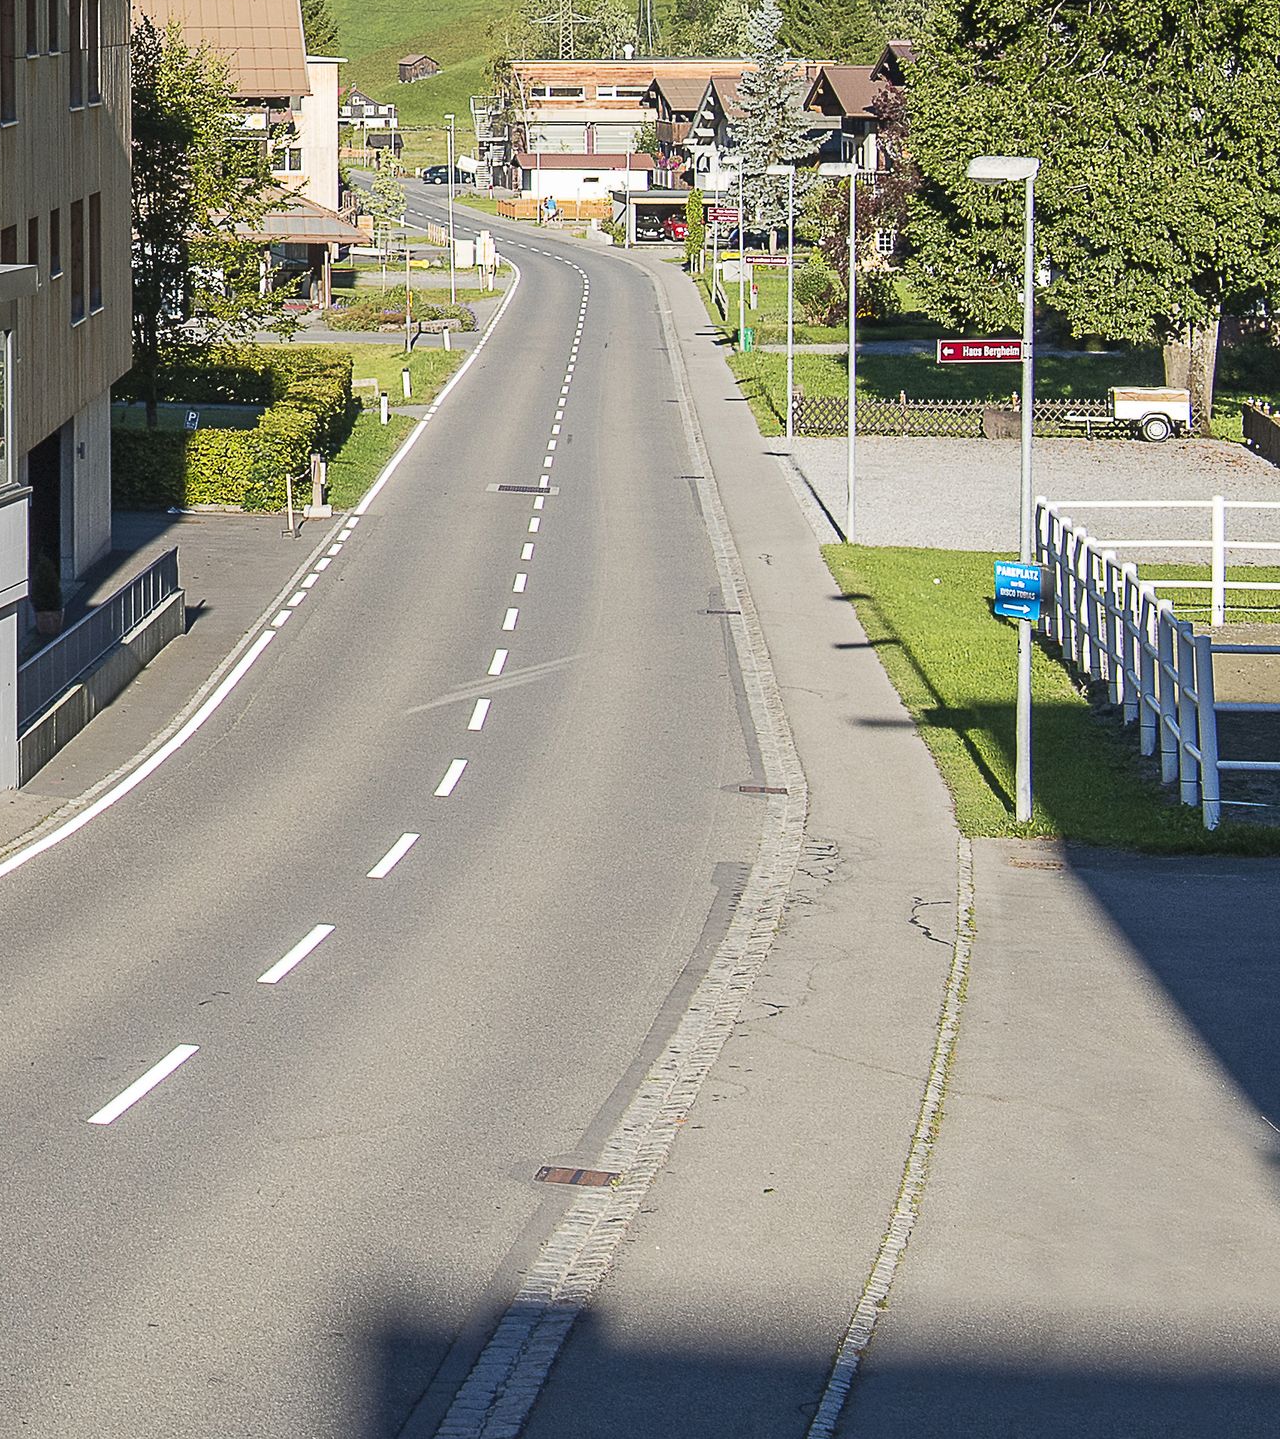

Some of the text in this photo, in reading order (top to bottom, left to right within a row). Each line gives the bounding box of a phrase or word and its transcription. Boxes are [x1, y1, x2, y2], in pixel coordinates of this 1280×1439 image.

[962, 345, 1020, 358] Haus Bergheim
[188, 411, 197, 421] P
[996, 565, 1039, 581] PARKPLATZ
